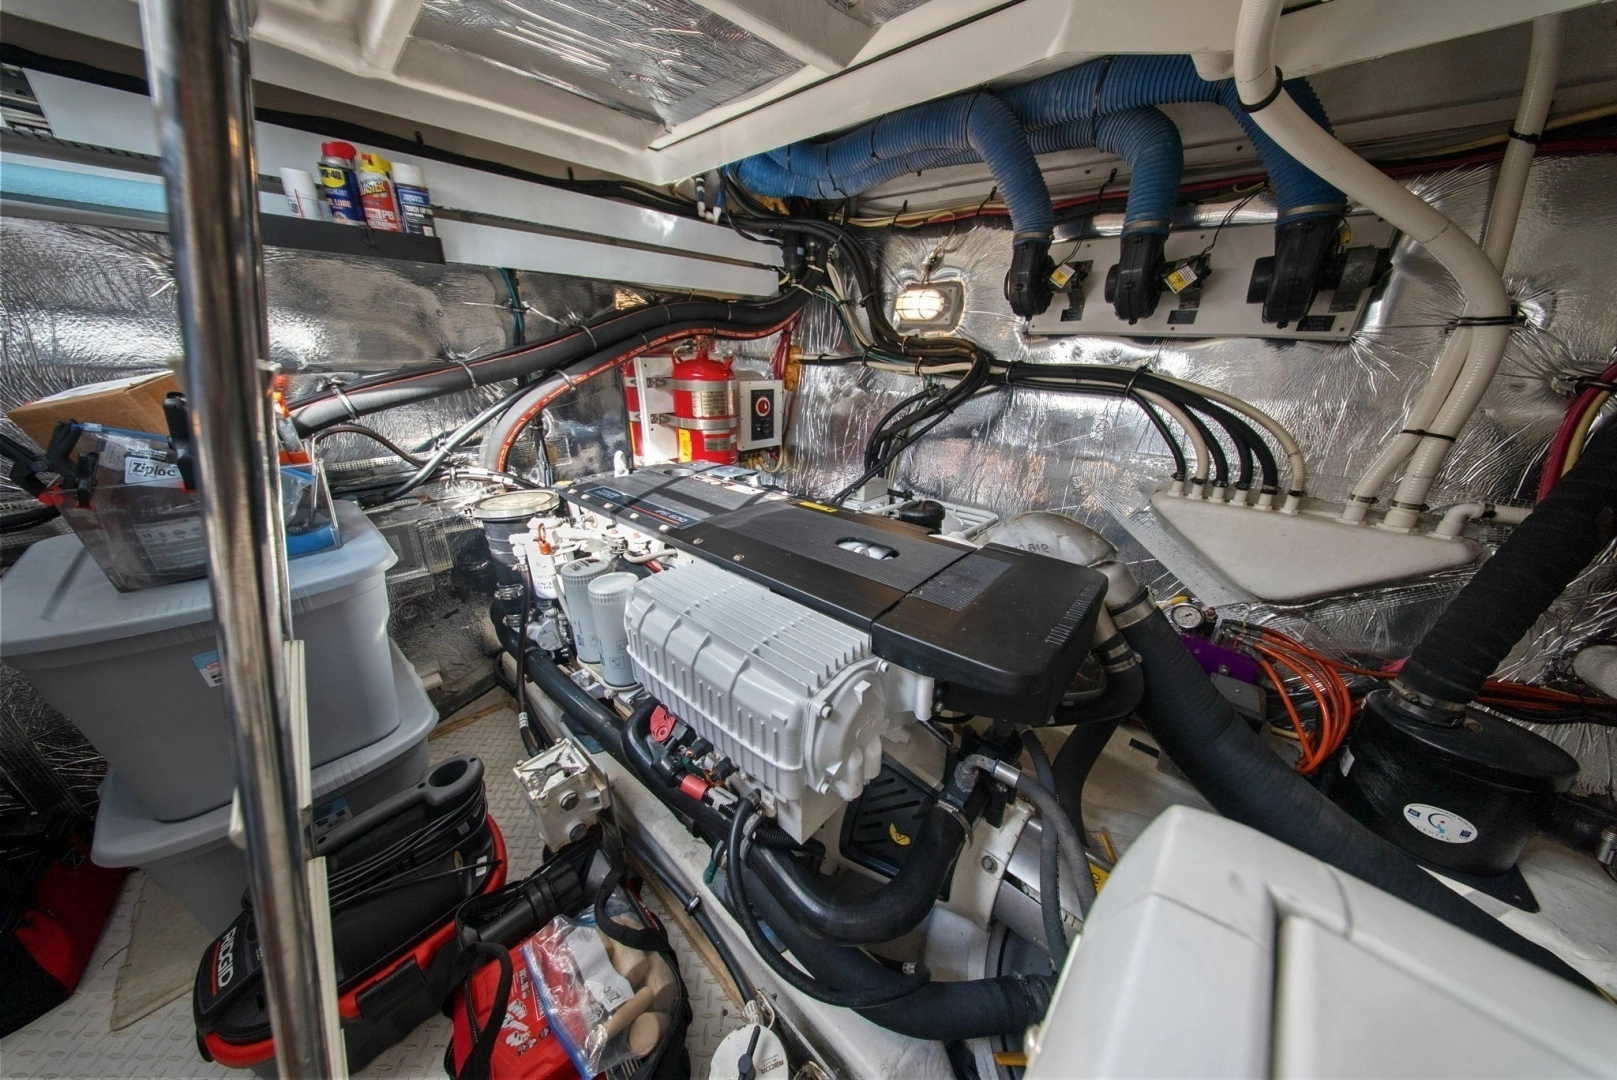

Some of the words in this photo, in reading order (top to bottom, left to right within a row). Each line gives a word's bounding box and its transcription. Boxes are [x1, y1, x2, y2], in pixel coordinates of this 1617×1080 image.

[382, 210, 395, 220] PB
[132, 462, 176, 477] Ziploc
[1416, 825, 1452, 841] CENTEK
[217, 926, 237, 987] RIDGID
